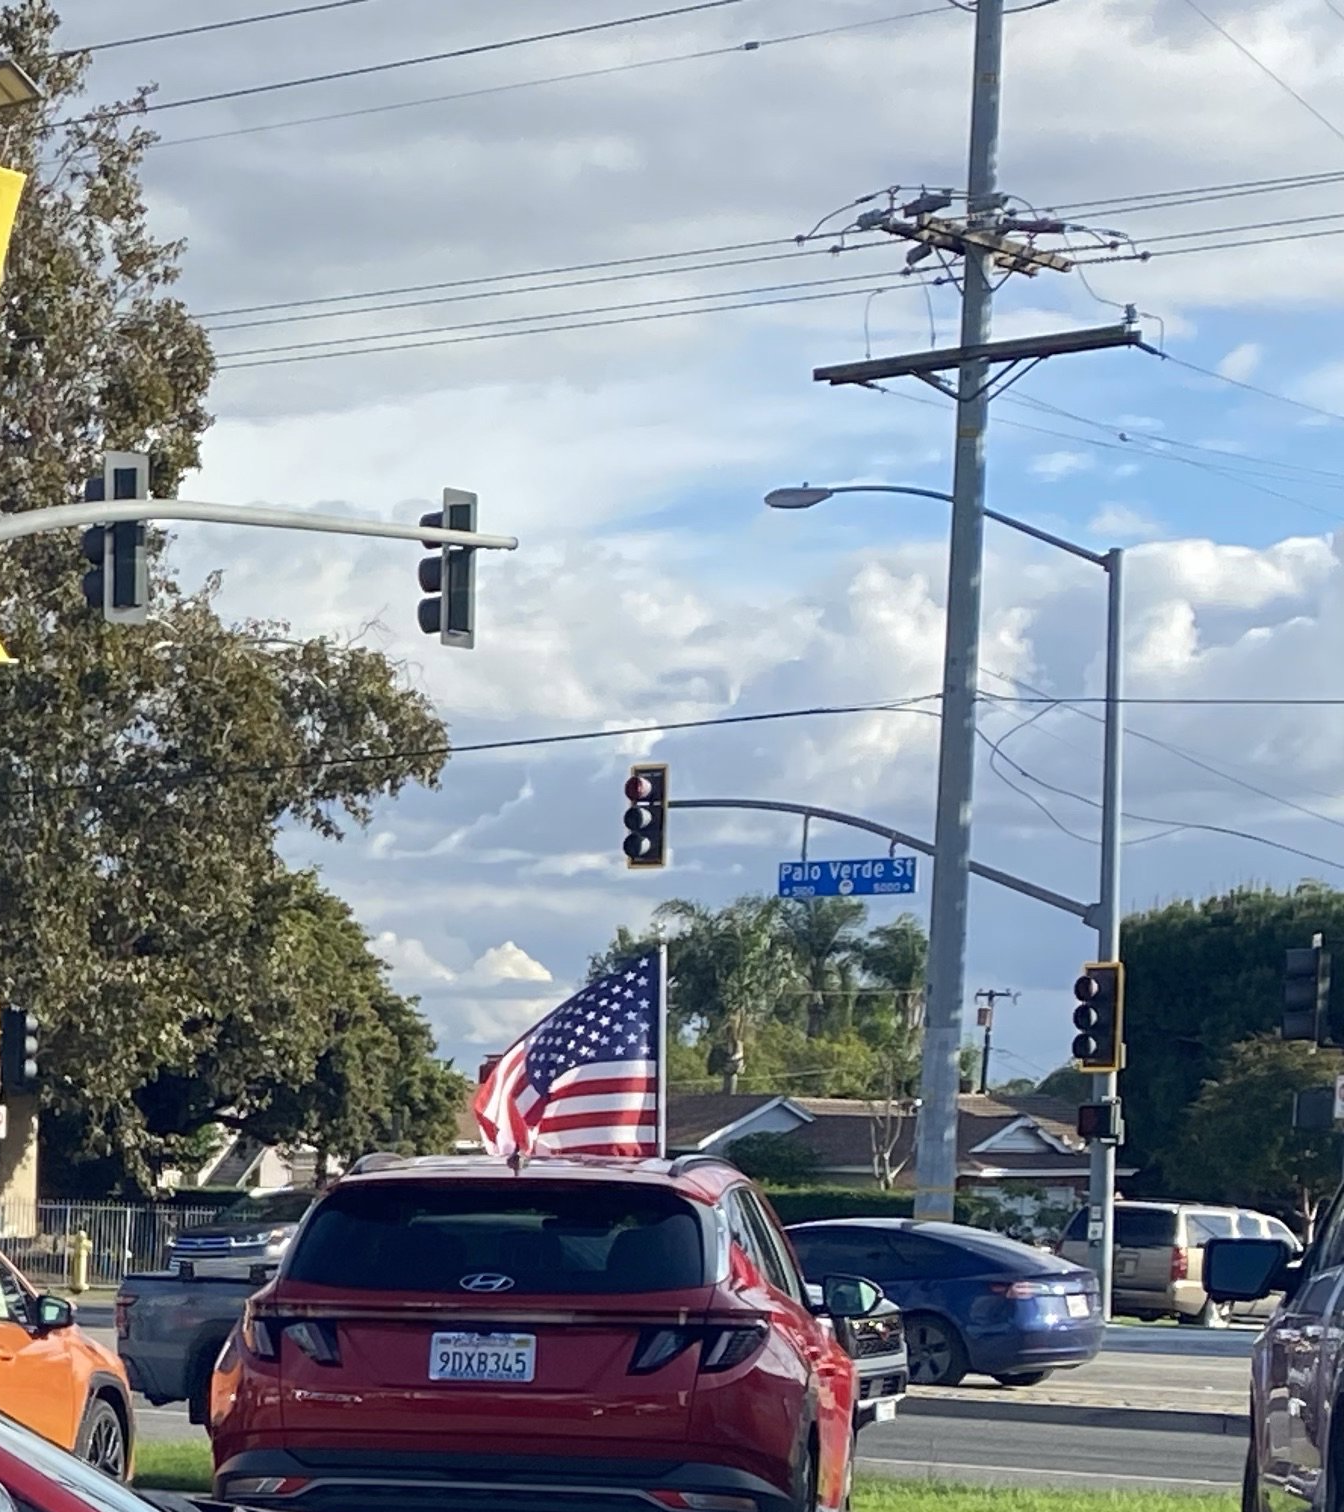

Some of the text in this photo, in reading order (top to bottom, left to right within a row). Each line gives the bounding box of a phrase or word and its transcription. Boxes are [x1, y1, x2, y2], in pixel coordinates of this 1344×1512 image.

[781, 859, 913, 881] Palo Verde St
[439, 1351, 526, 1374] 9DXB345
